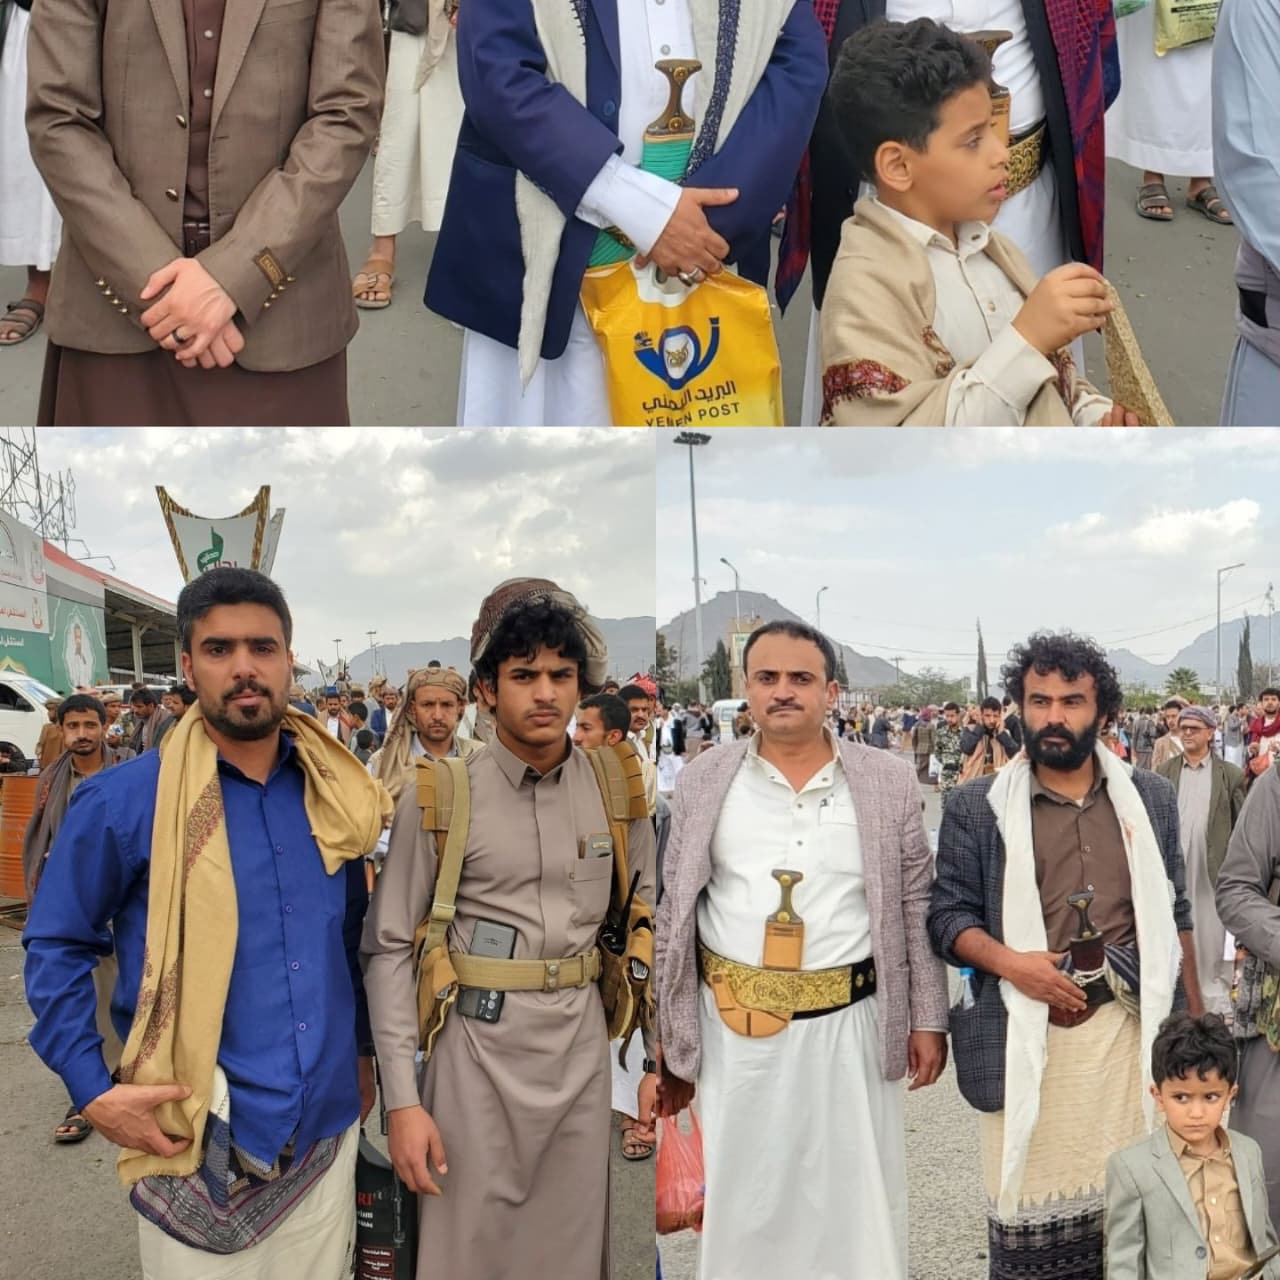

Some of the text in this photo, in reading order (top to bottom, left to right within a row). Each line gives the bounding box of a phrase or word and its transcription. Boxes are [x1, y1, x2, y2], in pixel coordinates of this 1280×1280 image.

[642, 381, 737, 412] البريد اليمني
[698, 402, 740, 419] POST
